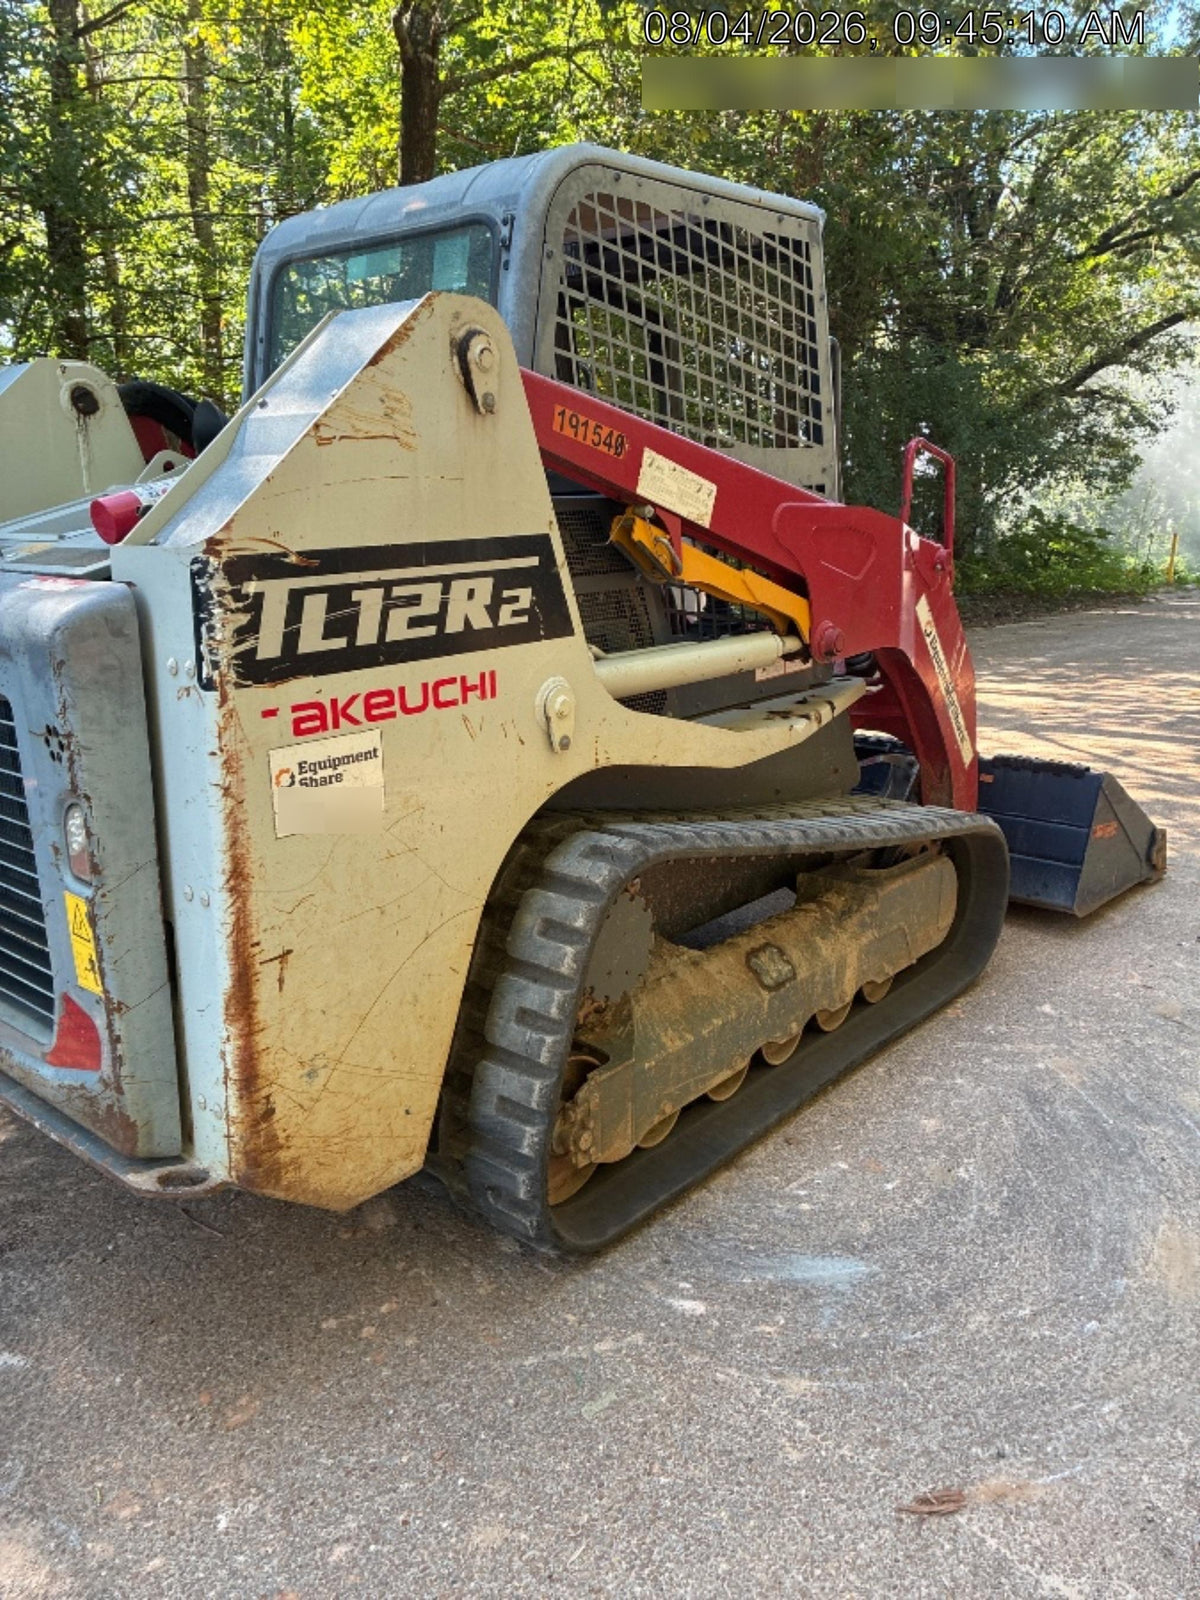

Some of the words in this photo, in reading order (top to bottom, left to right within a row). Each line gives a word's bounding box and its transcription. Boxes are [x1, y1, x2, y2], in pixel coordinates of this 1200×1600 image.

[557, 407, 627, 458] 191540
[297, 746, 380, 776] Equipment
[298, 771, 344, 788] Share
